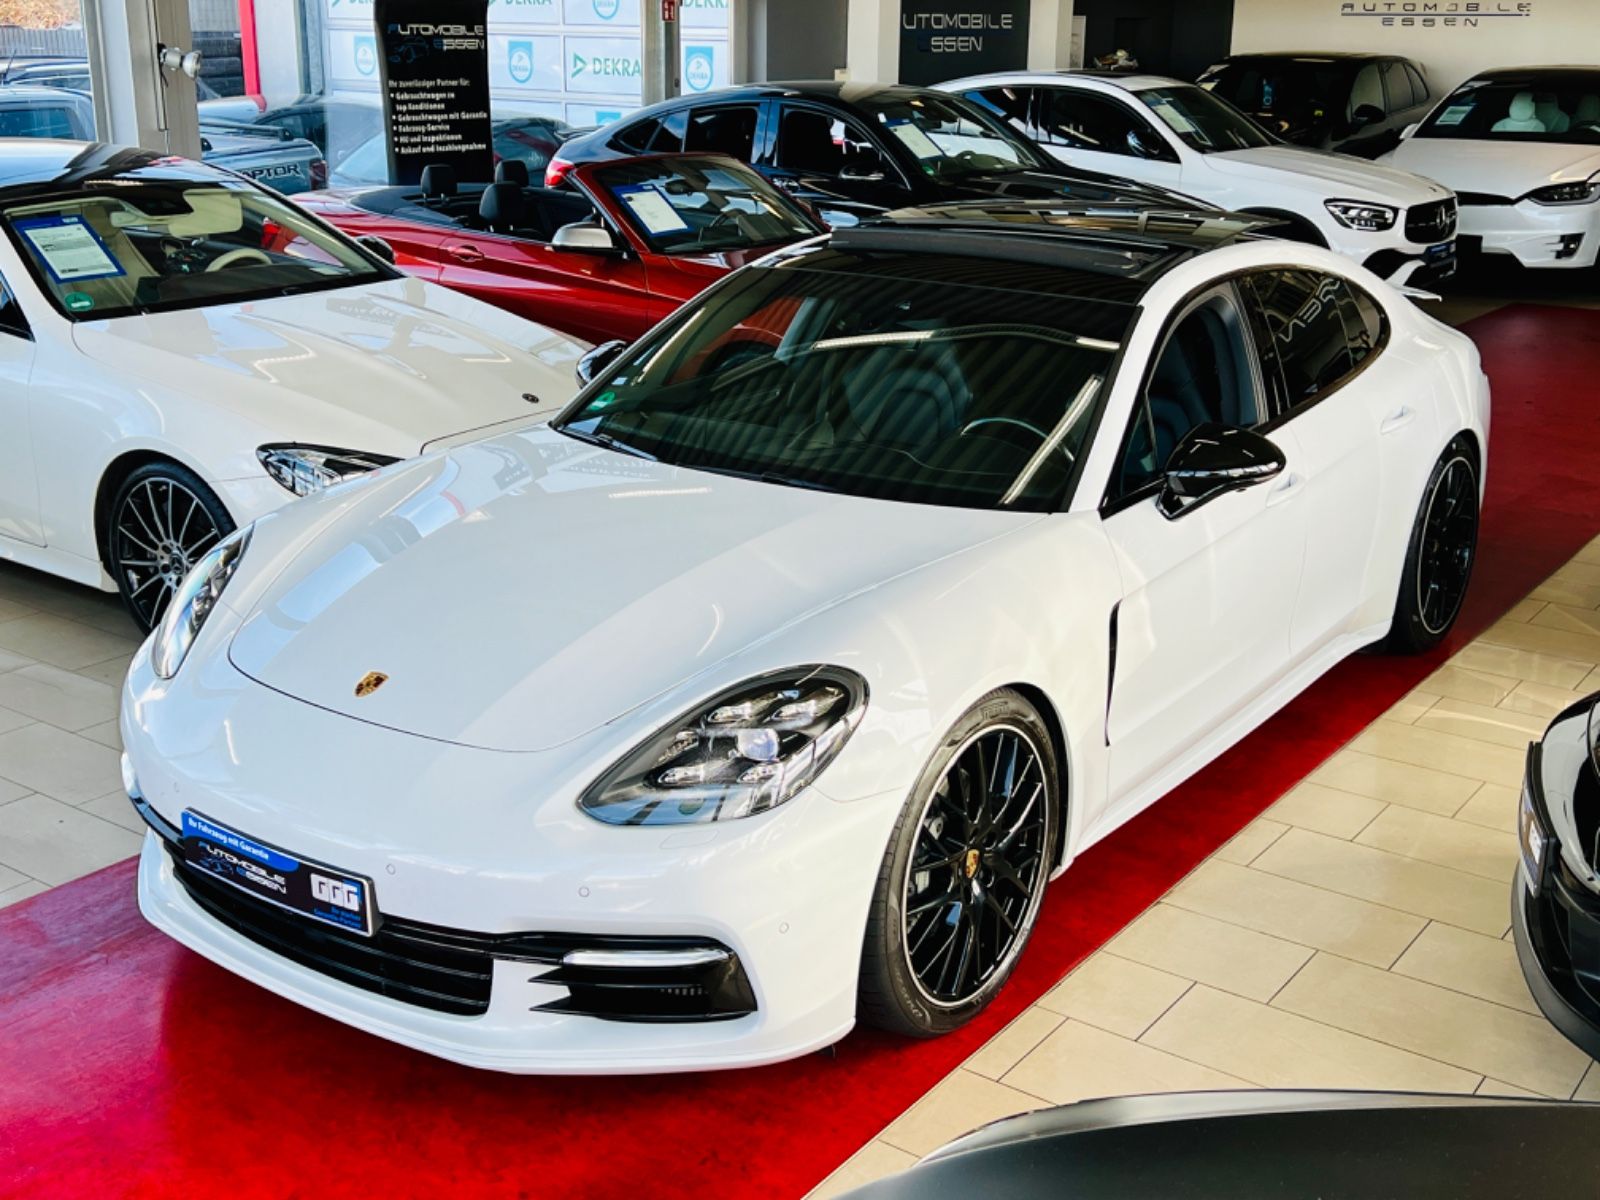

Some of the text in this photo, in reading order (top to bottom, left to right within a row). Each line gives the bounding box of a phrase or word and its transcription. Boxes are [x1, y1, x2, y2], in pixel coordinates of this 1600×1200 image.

[902, 13, 1013, 29] UTOMOBILE
[1381, 17, 1479, 27] ESSEN
[592, 57, 641, 76] DEKRA
[460, 111, 488, 120] Garantie
[241, 163, 301, 179] APTOR
